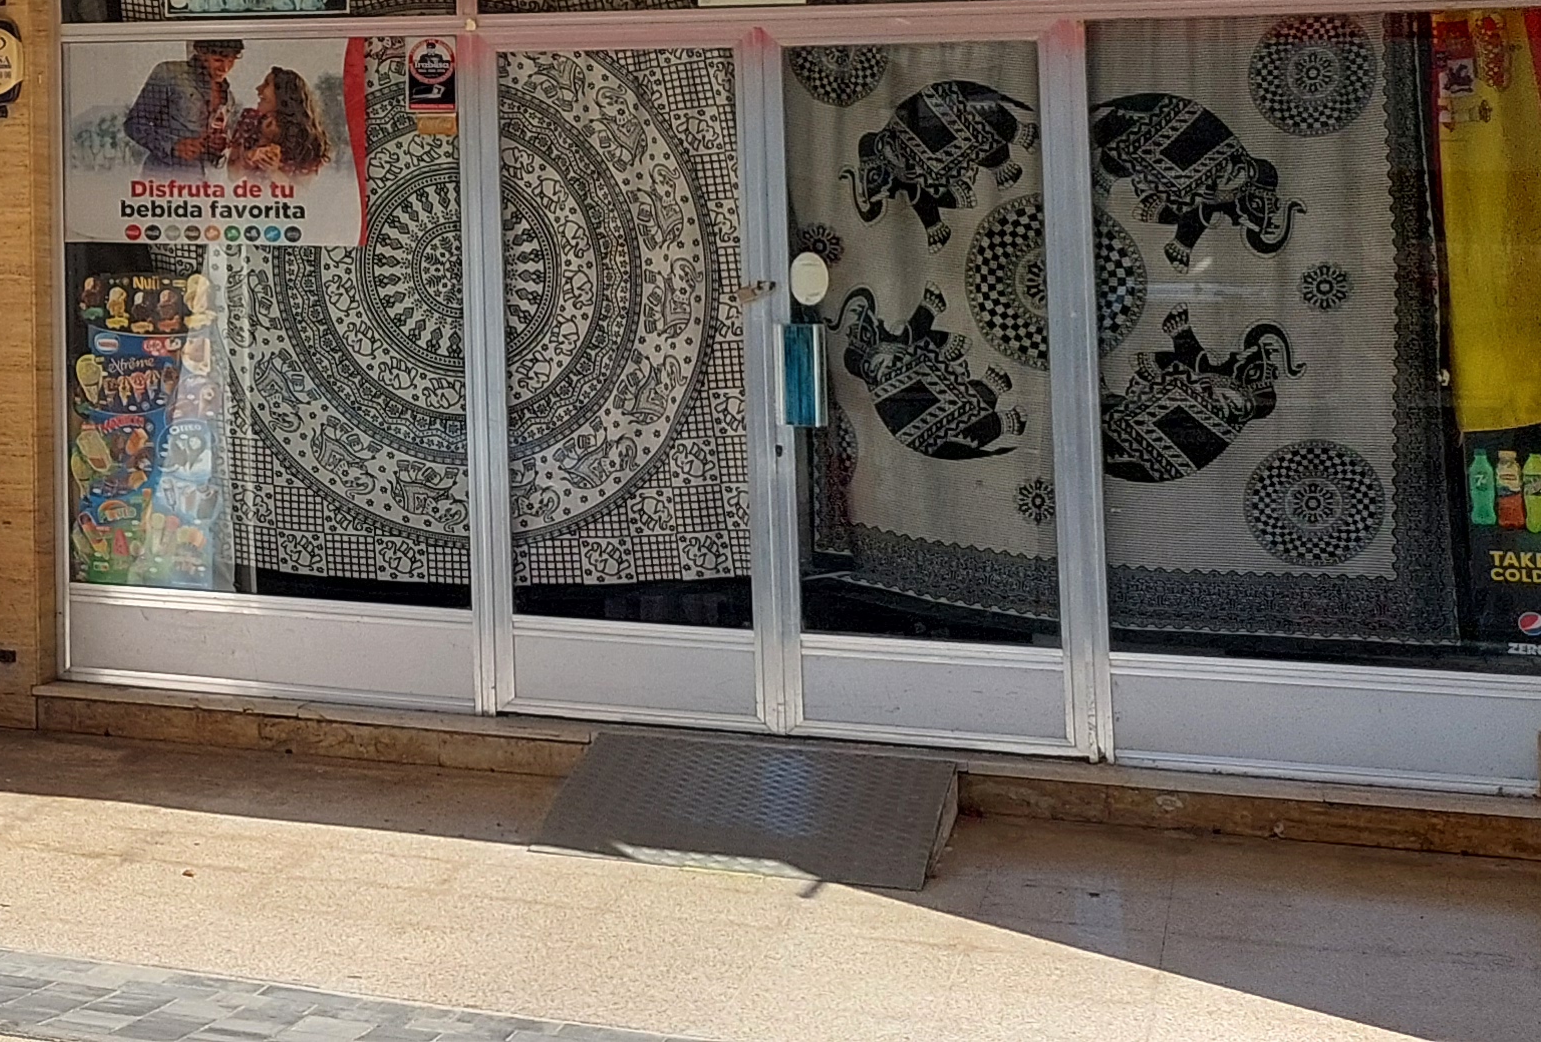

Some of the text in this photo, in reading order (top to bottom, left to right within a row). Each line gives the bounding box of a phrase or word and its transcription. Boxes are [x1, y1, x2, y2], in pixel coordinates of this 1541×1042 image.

[130, 180, 295, 198] Disfruta de tu
[120, 200, 306, 219] bebida favorita
[1507, 642, 1541, 656] ZER
